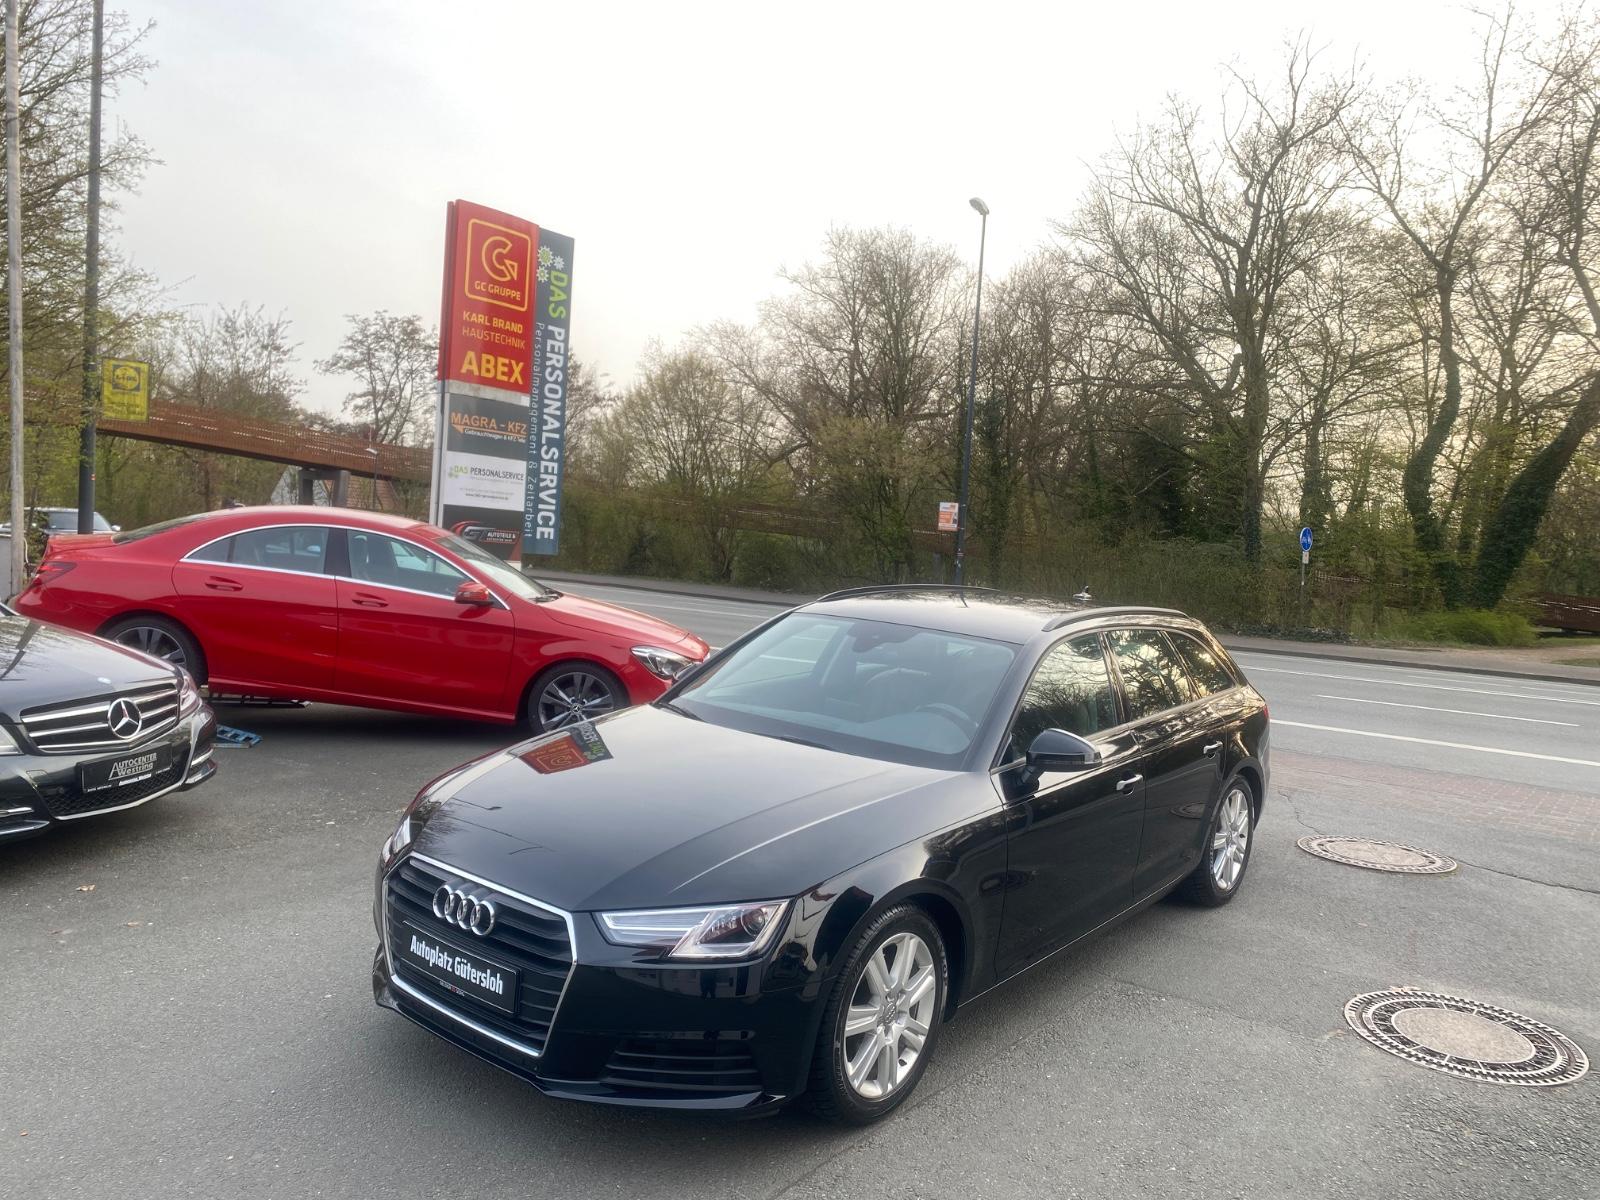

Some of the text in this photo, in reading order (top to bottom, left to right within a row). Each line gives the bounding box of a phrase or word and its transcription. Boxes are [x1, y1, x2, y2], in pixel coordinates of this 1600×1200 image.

[474, 280, 521, 301] GC GRUPPE
[463, 311, 523, 334] KARL BRAND
[462, 327, 525, 350] HAUSTECHNIK
[460, 350, 525, 385] ABEX
[528, 322, 545, 454] Personalmanagement
[536, 269, 568, 540] DAS PERSONALSERVICE
[451, 411, 497, 430] MAGRA
[507, 421, 528, 435] KFZ
[454, 465, 469, 474] DAS
[470, 467, 524, 481] PERSONALSERVICE
[524, 477, 537, 537] Zeitarbeit
[108, 752, 158, 780] AUTOCENTER
[118, 762, 154, 777] Westring
[410, 934, 453, 972] Autoplatz
[454, 956, 504, 995] Gütersloh
